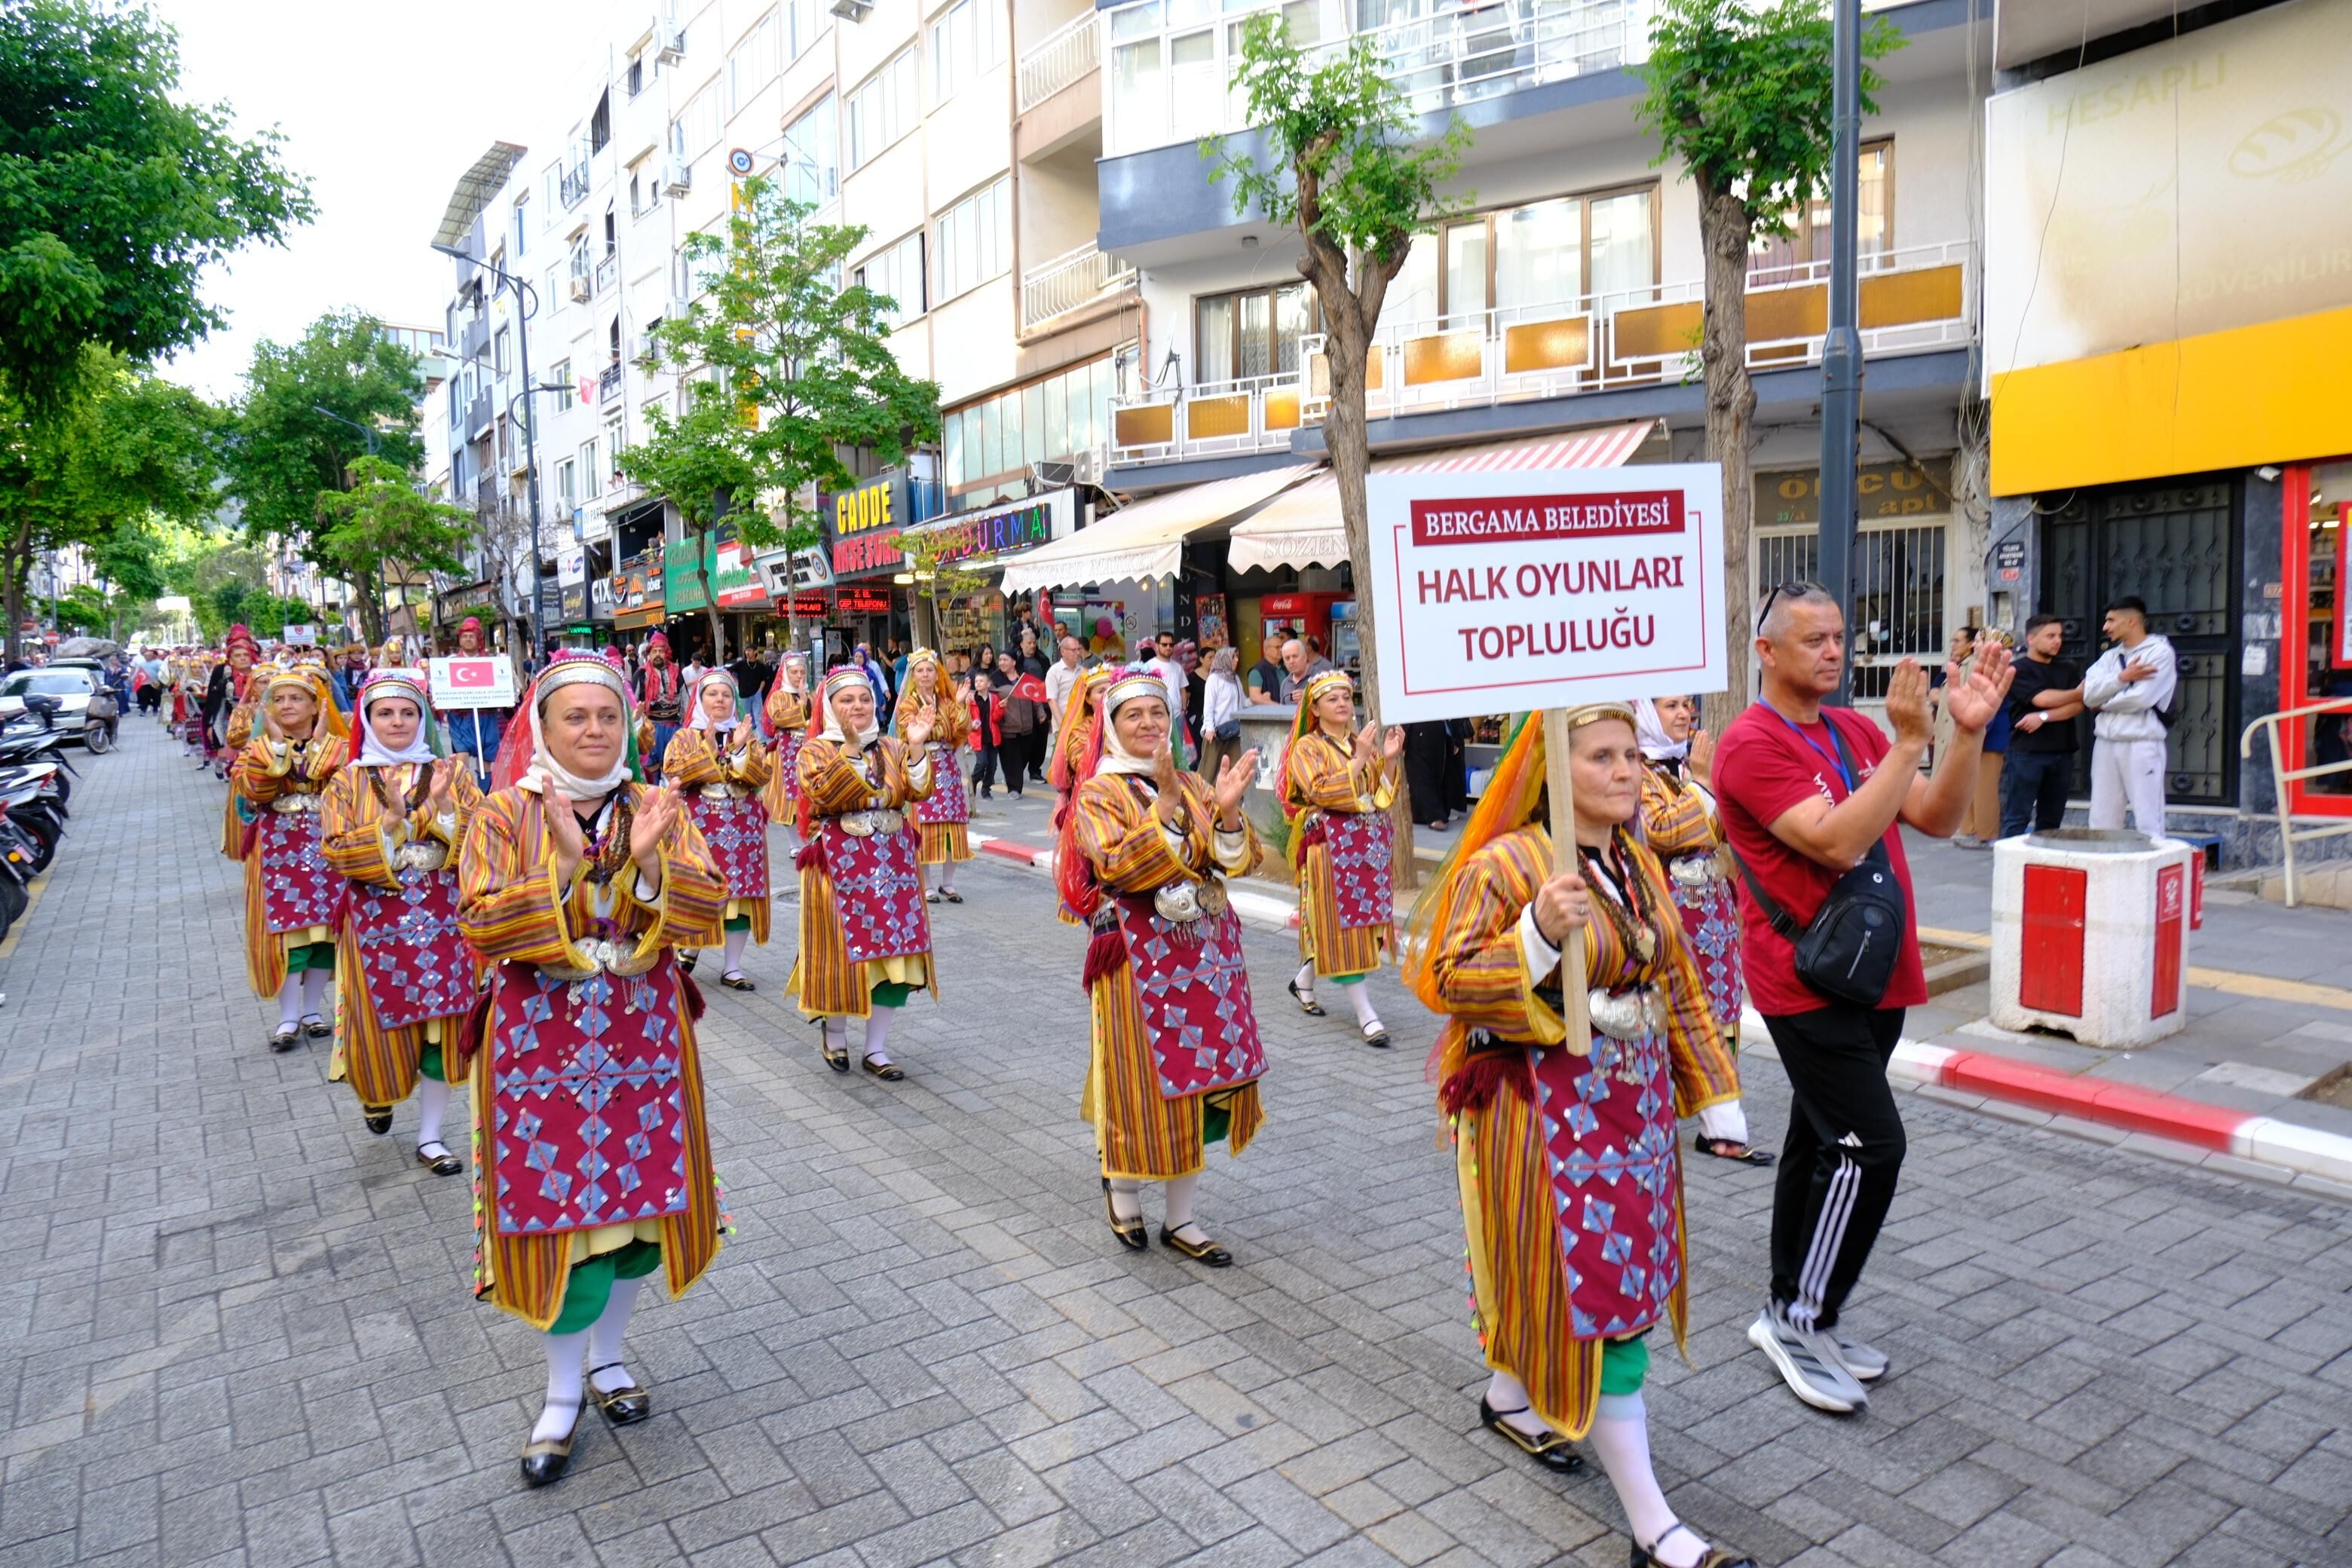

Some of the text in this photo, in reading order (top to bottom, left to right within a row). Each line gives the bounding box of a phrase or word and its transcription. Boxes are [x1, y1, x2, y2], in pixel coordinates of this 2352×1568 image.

[1778, 464, 1924, 499] ÖCÜ
[836, 481, 892, 534] CADDE
[1425, 496, 1671, 537] BERGAMA BELEDİYESİ
[833, 528, 902, 574] AKSESUAR
[1263, 533, 1350, 559] SÖZEN
[1418, 556, 1684, 604] HALK OYUNLARI
[1458, 605, 1655, 662] TOPLULUĞU
